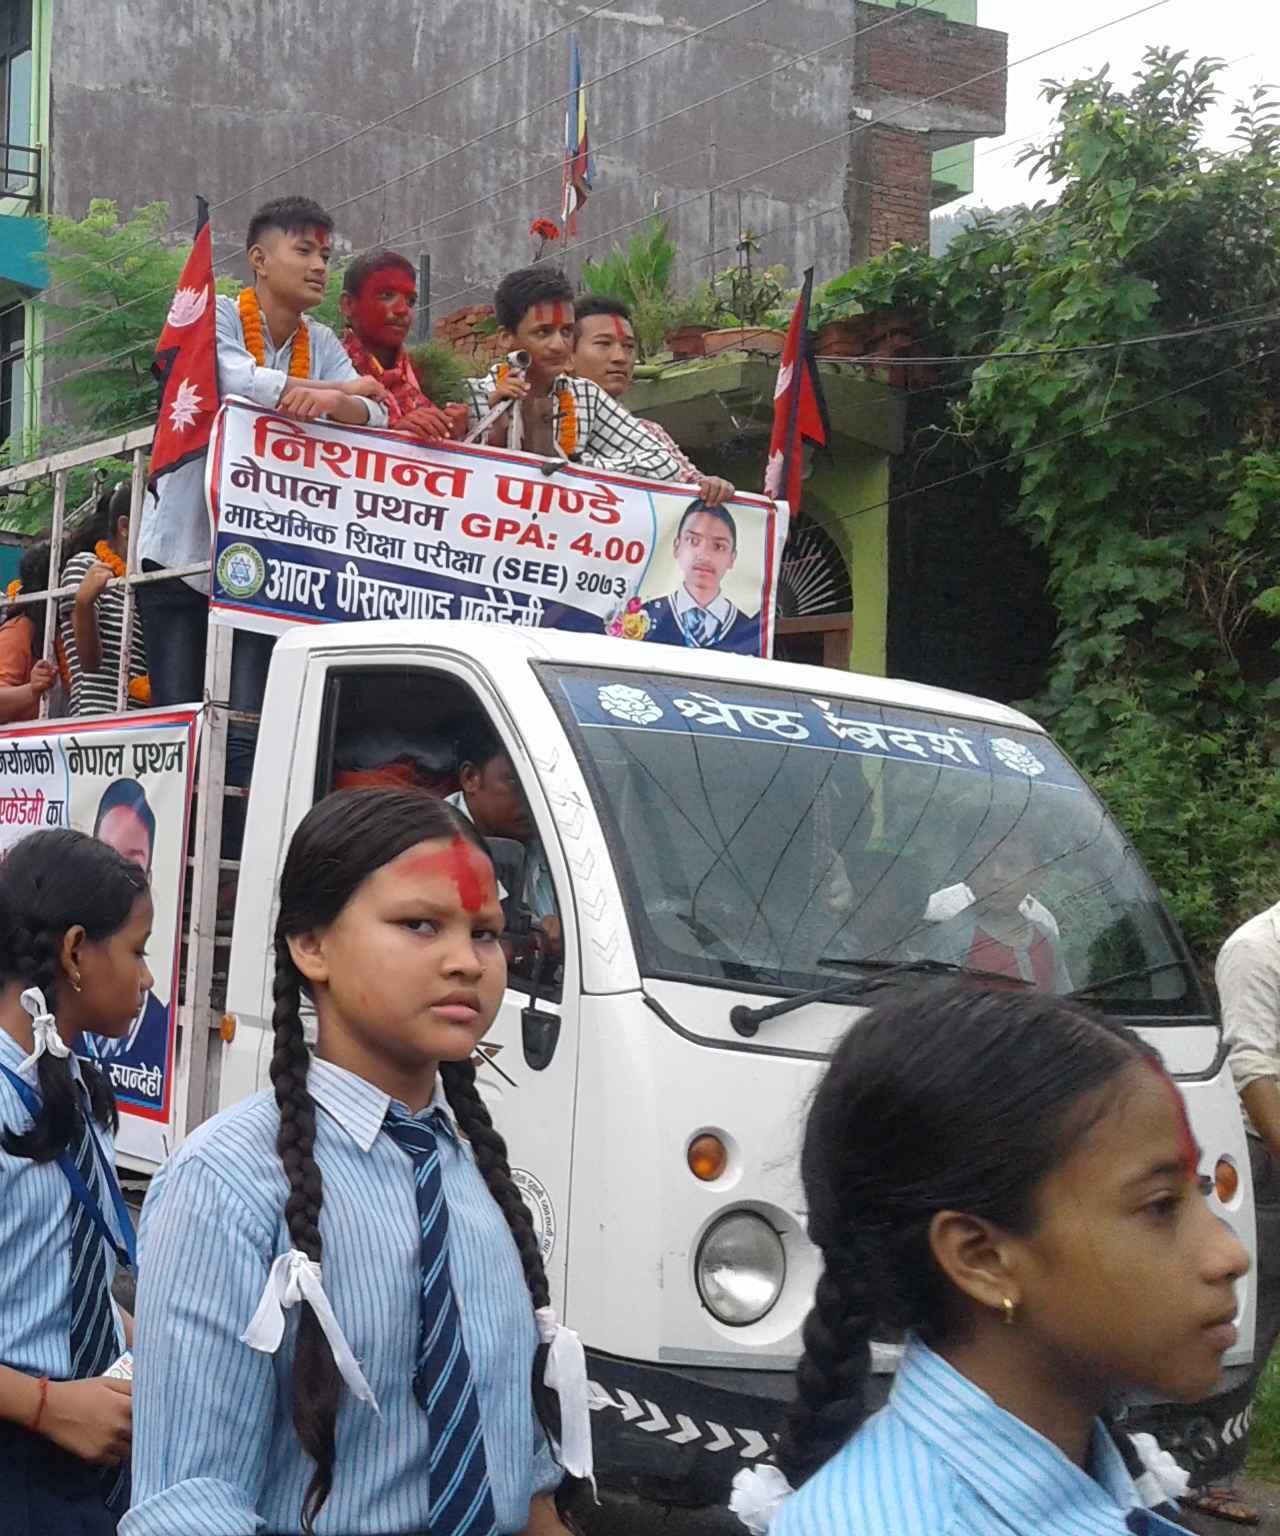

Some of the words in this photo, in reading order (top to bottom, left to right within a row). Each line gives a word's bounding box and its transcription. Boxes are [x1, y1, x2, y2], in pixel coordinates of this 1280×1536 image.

[254, 415, 473, 498] निशान्त
[495, 474, 624, 525] पाण्डे
[230, 456, 341, 509] नेपाल
[354, 489, 449, 531] प्रथम
[461, 512, 557, 550] GPA:
[570, 532, 645, 564] 4.00
[224, 503, 338, 546] माध्यमिक
[345, 522, 406, 559] शिक्षा
[413, 540, 485, 574] परीक्षा
[493, 555, 568, 593] (SEE)
[576, 571, 627, 599] २०७३
[264, 558, 331, 610] आवर
[673, 691, 810, 739] श्रेष्ठ
[65, 736, 125, 776] नेपाल
[132, 741, 186, 779] प्रथम
[46, 799, 65, 826] का
[109, 1062, 162, 1097] रूपन्देही
